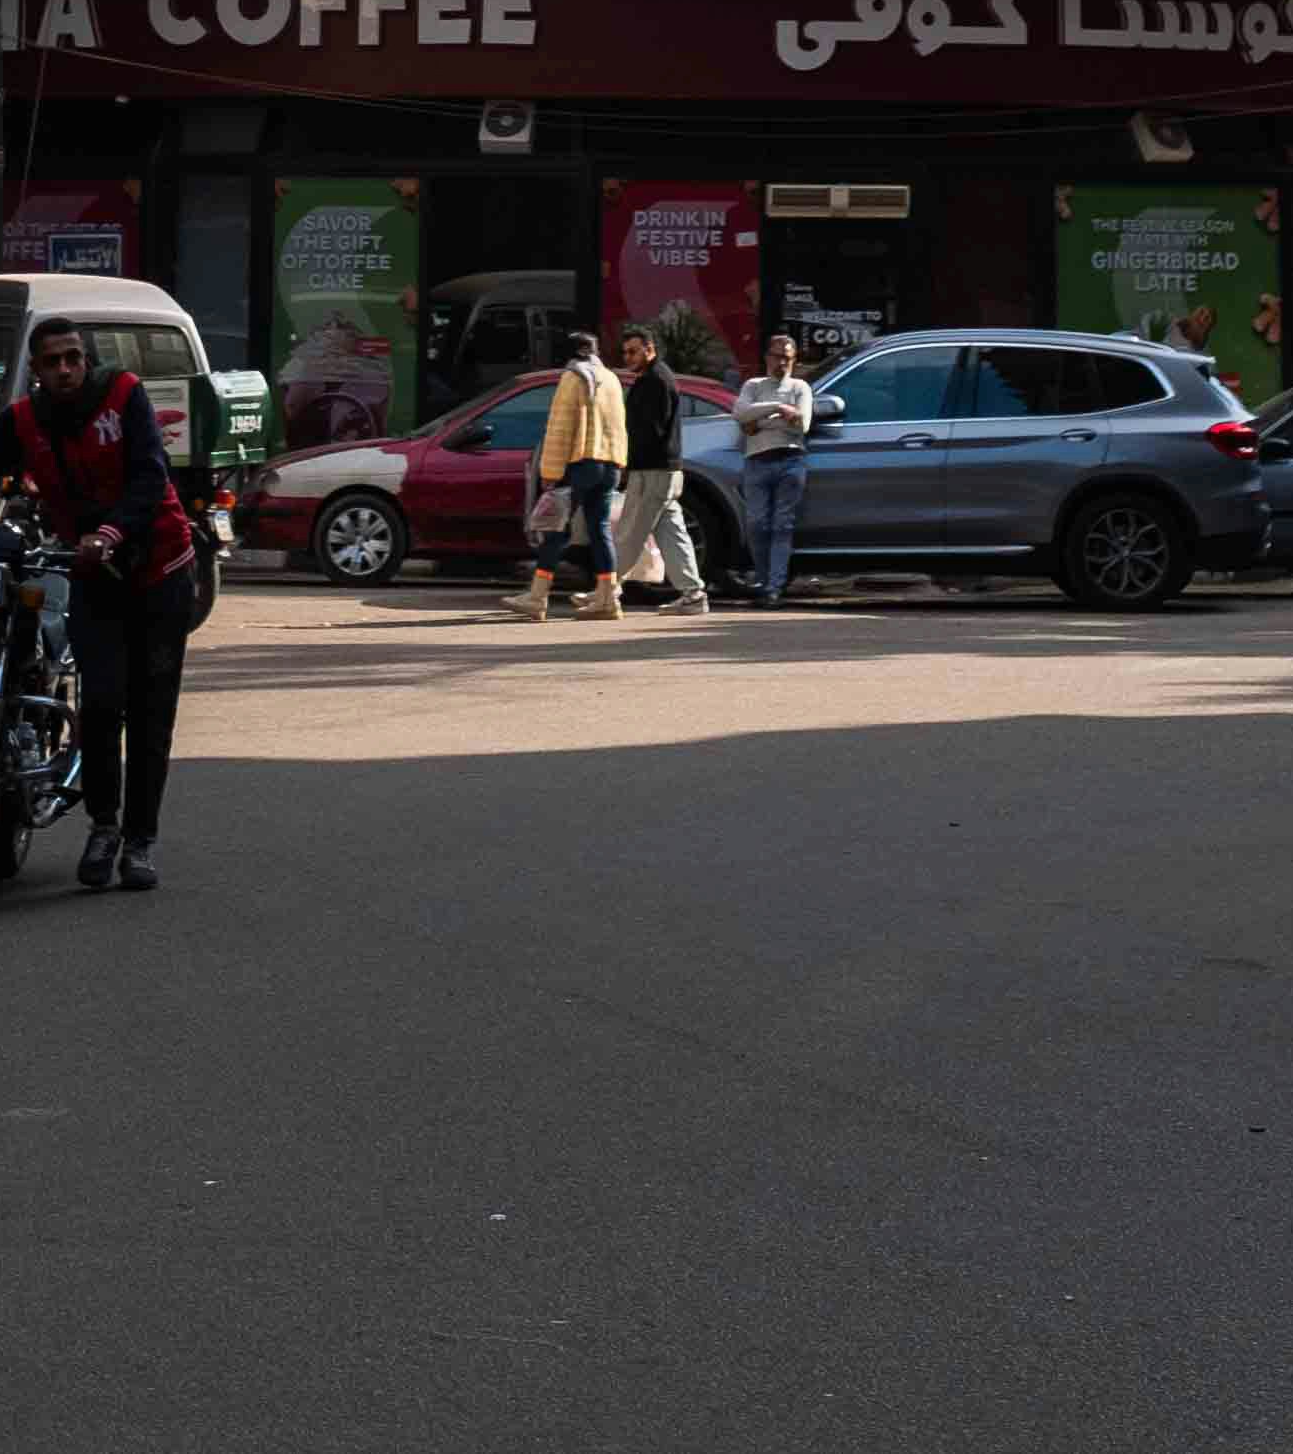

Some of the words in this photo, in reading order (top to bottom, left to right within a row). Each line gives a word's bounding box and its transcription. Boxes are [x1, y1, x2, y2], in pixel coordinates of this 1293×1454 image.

[305, 214, 371, 231] SAVOR
[634, 211, 700, 227] DRINK
[705, 211, 727, 227] IN
[291, 236, 331, 250] THE
[338, 235, 383, 250] GIFT
[636, 229, 724, 246] FESTIVE
[282, 253, 308, 269] OF
[313, 253, 393, 269] TOFFEE
[649, 249, 711, 267] VIBES
[1091, 251, 1240, 270] GINGERBREAD
[309, 273, 364, 289] CAKE
[1135, 274, 1199, 292] LATTE
